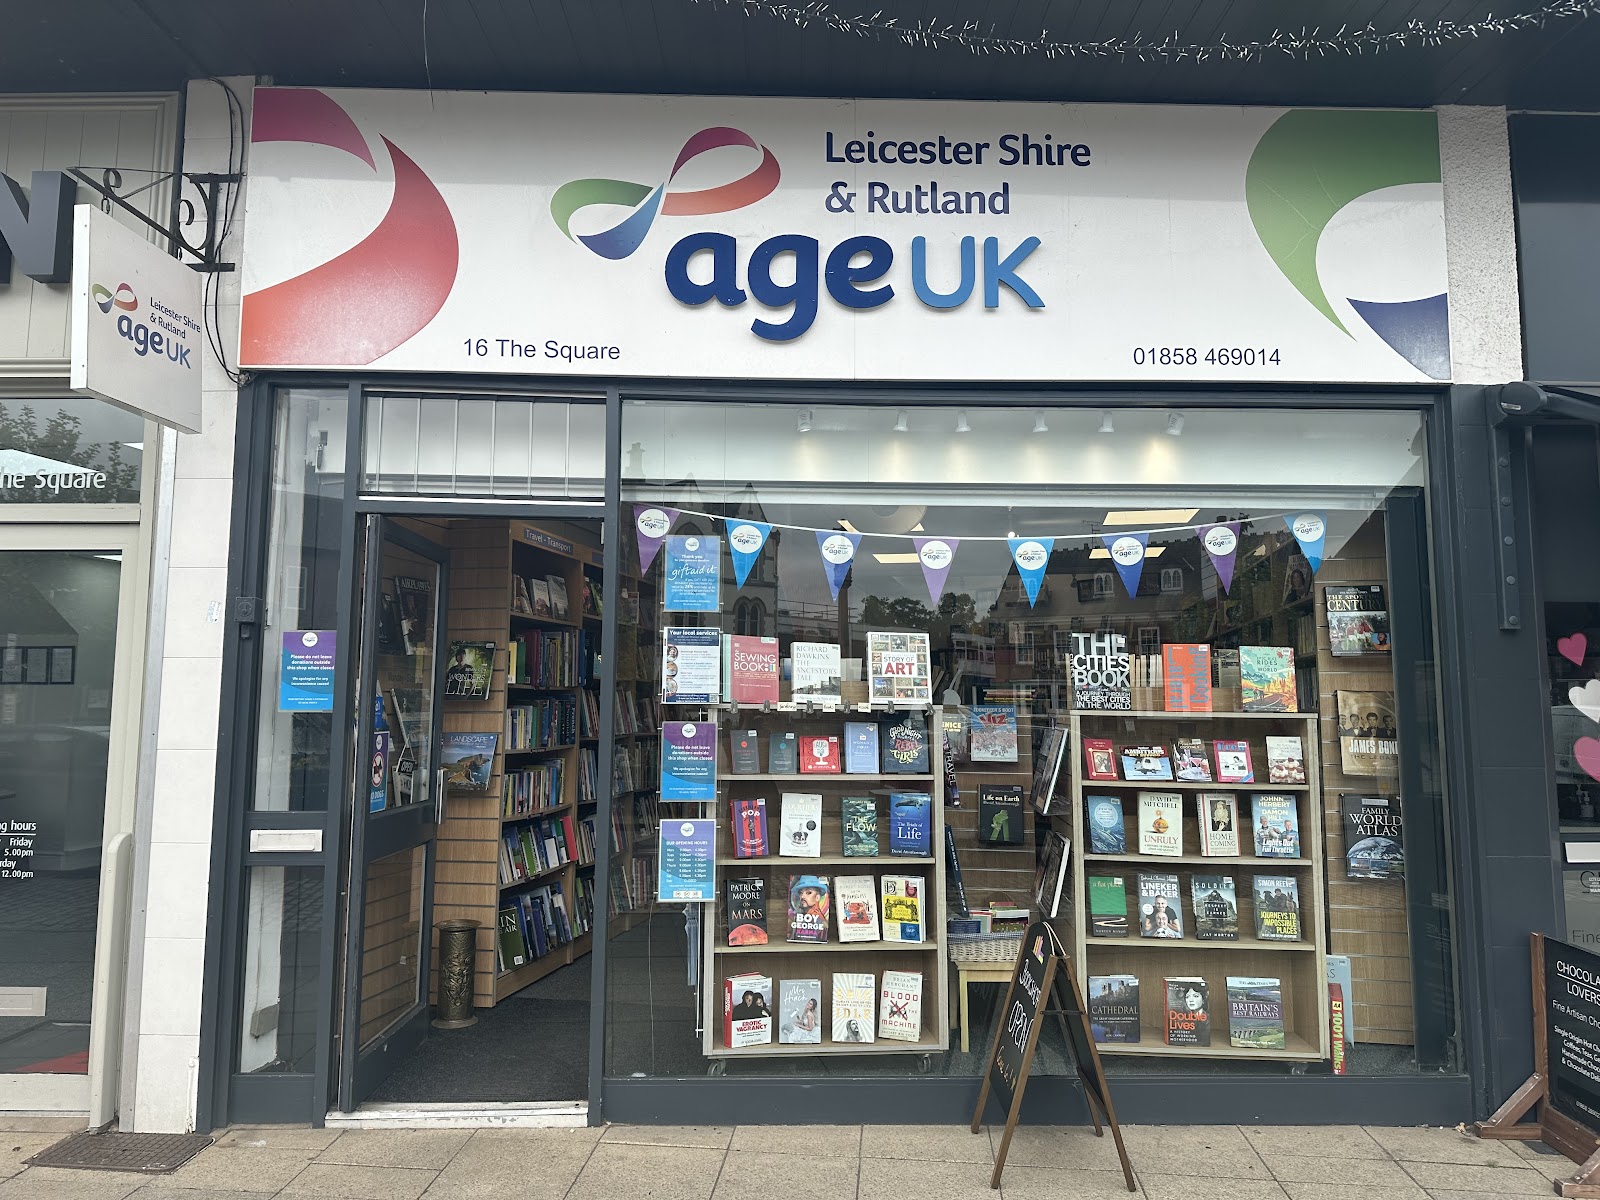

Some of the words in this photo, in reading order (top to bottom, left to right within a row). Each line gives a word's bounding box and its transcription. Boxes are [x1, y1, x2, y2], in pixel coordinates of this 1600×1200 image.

[826, 131, 990, 164] Leicester
[999, 134, 1091, 166] Shire
[825, 181, 856, 213] &
[867, 181, 1010, 214] Rutland
[665, 232, 895, 341] age
[912, 235, 1045, 308] UK
[150, 297, 181, 321] Leicester
[183, 316, 201, 333] Shire
[149, 313, 157, 323] &
[158, 316, 186, 339] Rutland
[117, 315, 164, 356] age
[166, 338, 191, 369] UK
[463, 339, 488, 356] 16
[496, 339, 536, 357] The
[544, 340, 621, 363] Square
[1133, 347, 1198, 365] 01858
[1204, 348, 1281, 365] 469014
[0, 466, 26, 489] he
[34, 468, 107, 494] Square
[526, 529, 543, 543] Travel
[547, 537, 571, 553] Transport
[796, 645, 828, 653] RICHARD
[1072, 633, 1129, 656] THE
[734, 652, 776, 663] SEWING
[1073, 655, 1130, 671] CITIES
[884, 663, 915, 675] ART
[449, 673, 486, 681] WONDERS
[1074, 670, 1130, 688] BOOK
[445, 680, 485, 696] LIFE
[979, 714, 1007, 725] VIZ
[450, 735, 488, 743] LANDSCAPE
[894, 739, 919, 752] REBEL
[1348, 739, 1375, 753] JAMES
[400, 761, 413, 773] OPEN
[947, 750, 957, 786] TRAVEL
[1004, 794, 1019, 802] Earth
[1143, 801, 1178, 809] MITCHELL
[741, 810, 760, 818] POP
[1361, 807, 1390, 815] FAMILY
[1349, 813, 1403, 826] WORLD
[11, 820, 37, 831] hours
[846, 823, 876, 831] FLOW
[1356, 825, 1398, 836] ATLAS
[897, 827, 922, 840] Life
[9, 837, 33, 848] Friday
[1144, 835, 1179, 844] UNRULY
[4, 848, 34, 858] 5.00pm
[1, 870, 34, 879] 12.00pm
[1141, 882, 1178, 891] LINEKER
[731, 909, 763, 920] MARS
[796, 913, 819, 922] BOY
[791, 922, 824, 930] GEORGE
[1264, 919, 1297, 927] IMPOSSIBLE
[504, 925, 518, 933] AIR
[1276, 926, 1297, 934] PLACES
[1572, 930, 1600, 944] Fine
[883, 990, 919, 1001] BLOOD
[1567, 982, 1600, 1007] LOVERS
[1091, 1005, 1138, 1015] CATHEDRAL
[1232, 1003, 1279, 1012] BRITAIN'S
[1552, 999, 1565, 1013] Fine
[1566, 1005, 1587, 1022] Artisan
[1169, 1011, 1207, 1021] Double
[736, 1024, 768, 1032] VAGRANCY
[881, 1019, 917, 1029] MACHINE
[1169, 1020, 1196, 1030] Lives
[1333, 1011, 1343, 1038] 1001
[1554, 1025, 1569, 1038] Single
[1583, 1039, 1593, 1049] Hot
[1561, 1057, 1566, 1065] &
[1567, 1060, 1590, 1078] Chocolate
